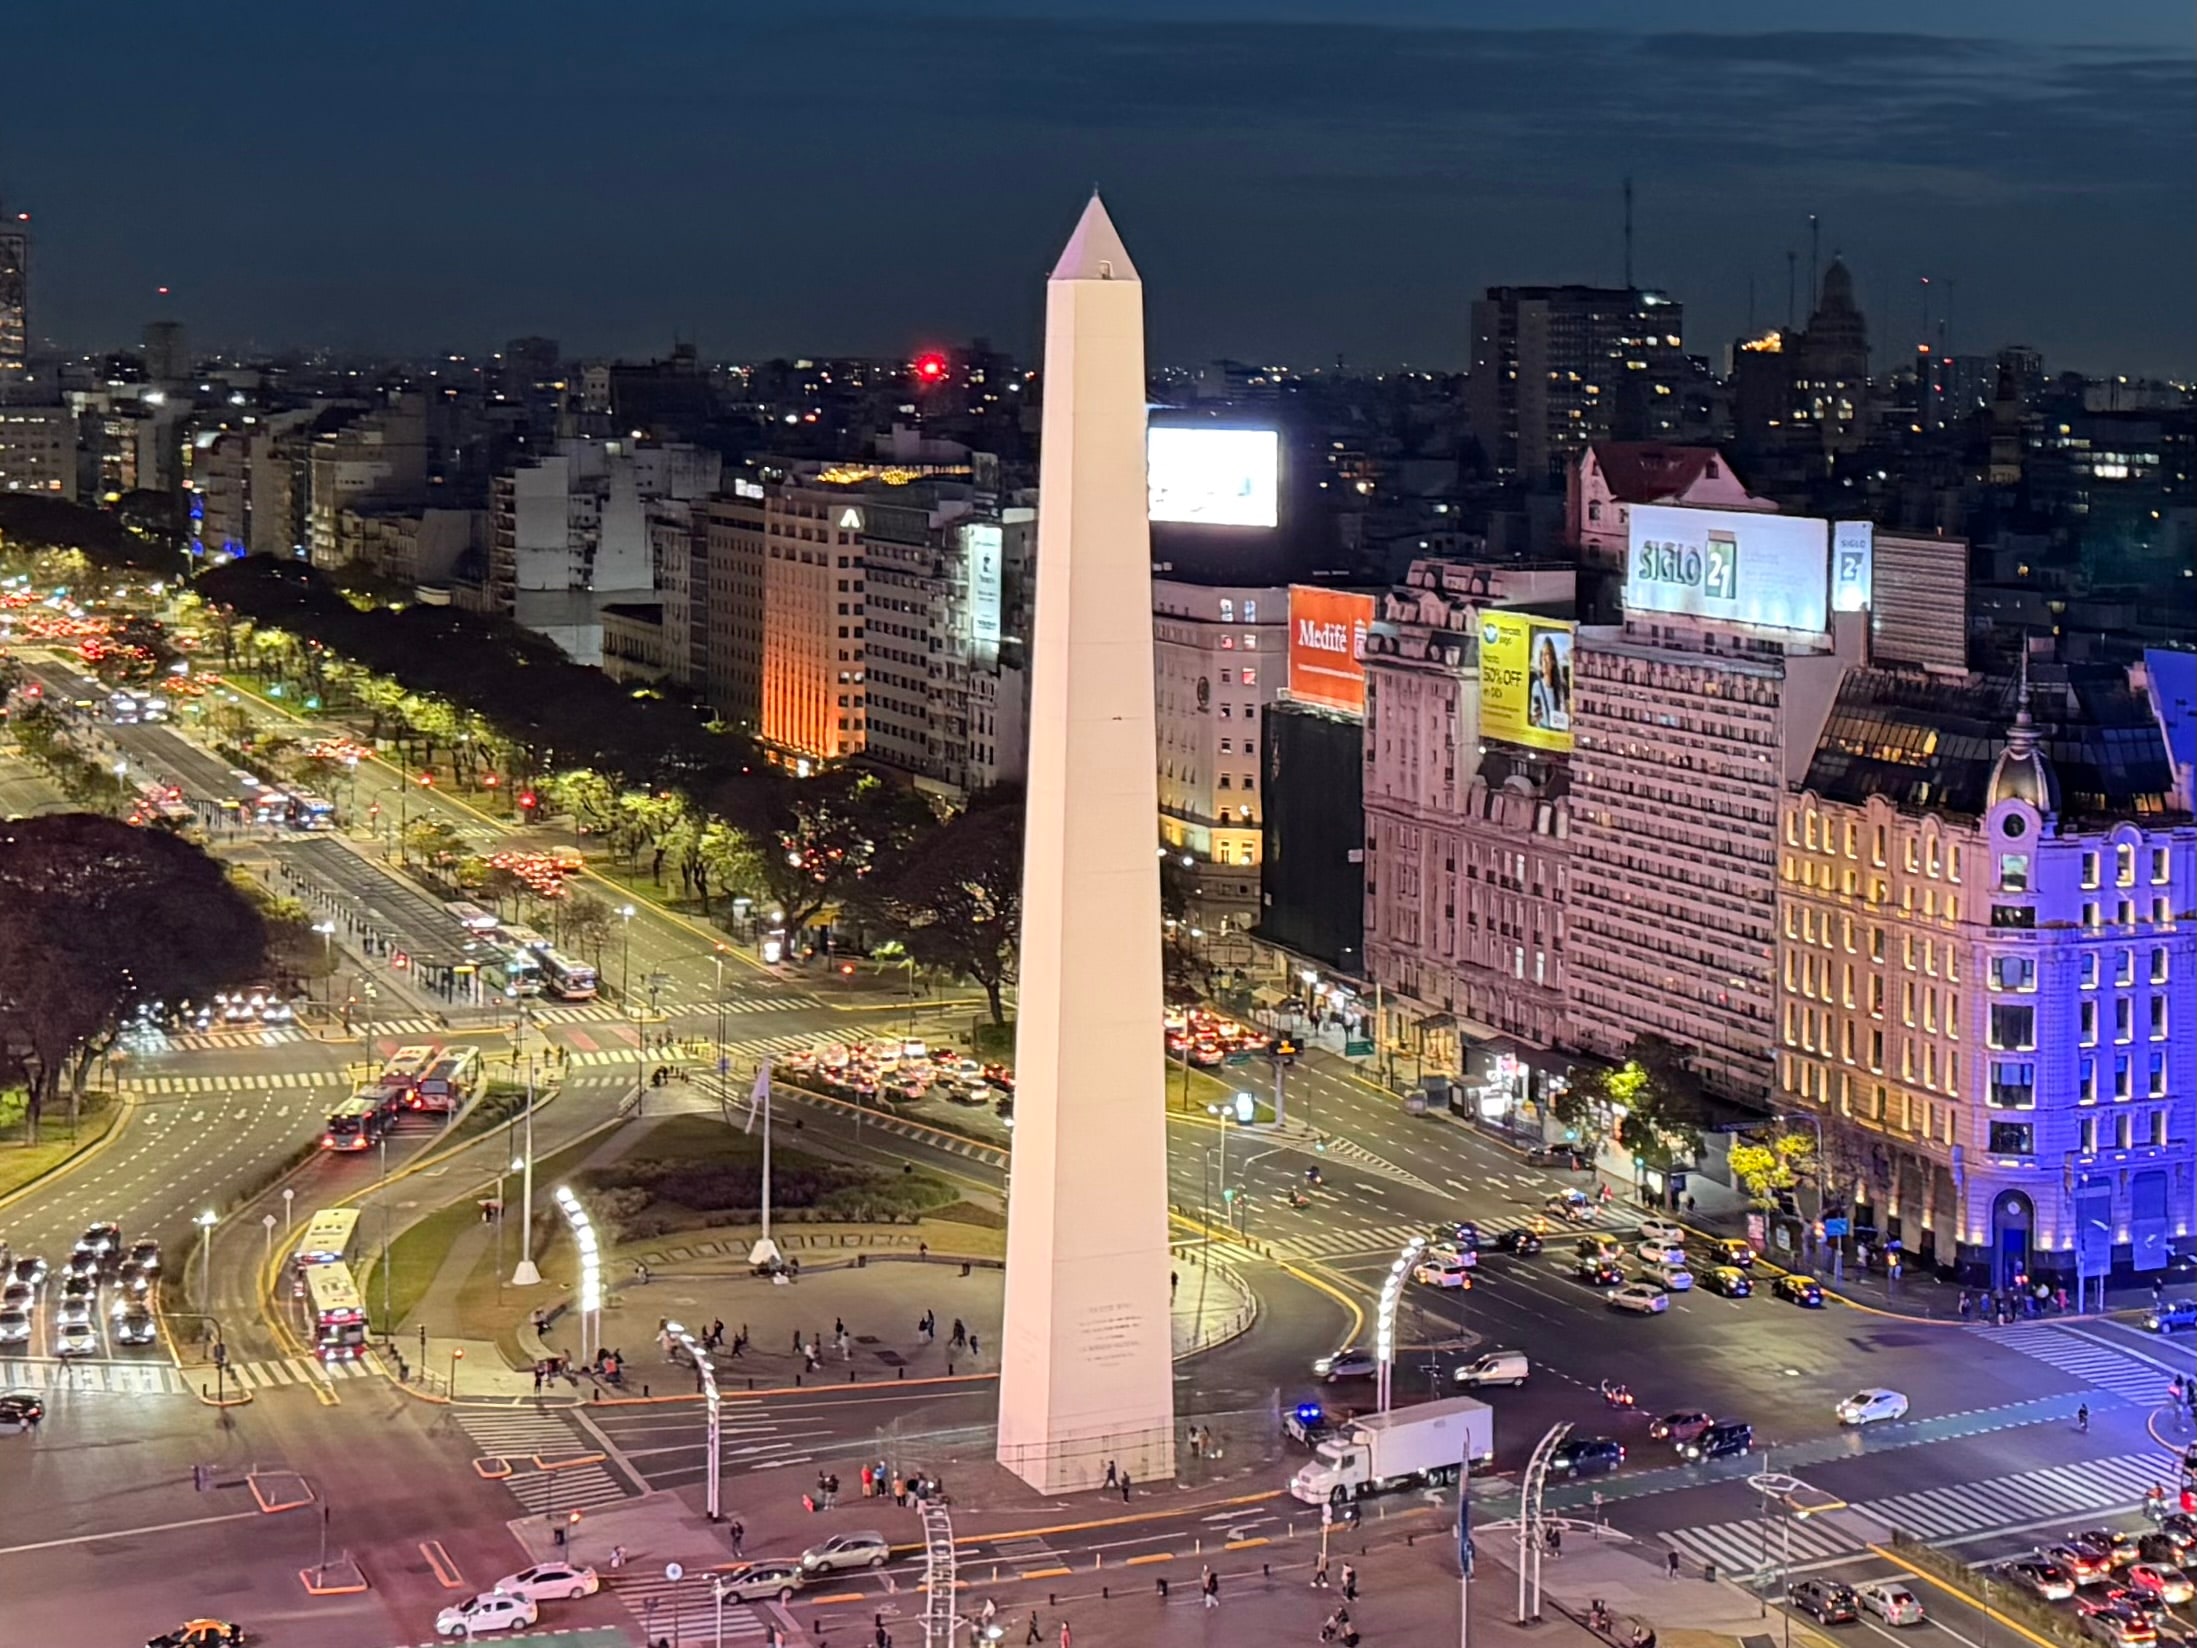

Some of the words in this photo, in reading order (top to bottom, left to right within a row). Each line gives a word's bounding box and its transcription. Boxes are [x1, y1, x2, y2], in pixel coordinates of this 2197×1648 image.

[1840, 539, 1866, 549] SIGLO
[1639, 540, 1702, 587] SIGLO
[1708, 552, 1731, 598] 21
[1298, 618, 1348, 653] Medifé
[1503, 669, 1522, 687] OFF
